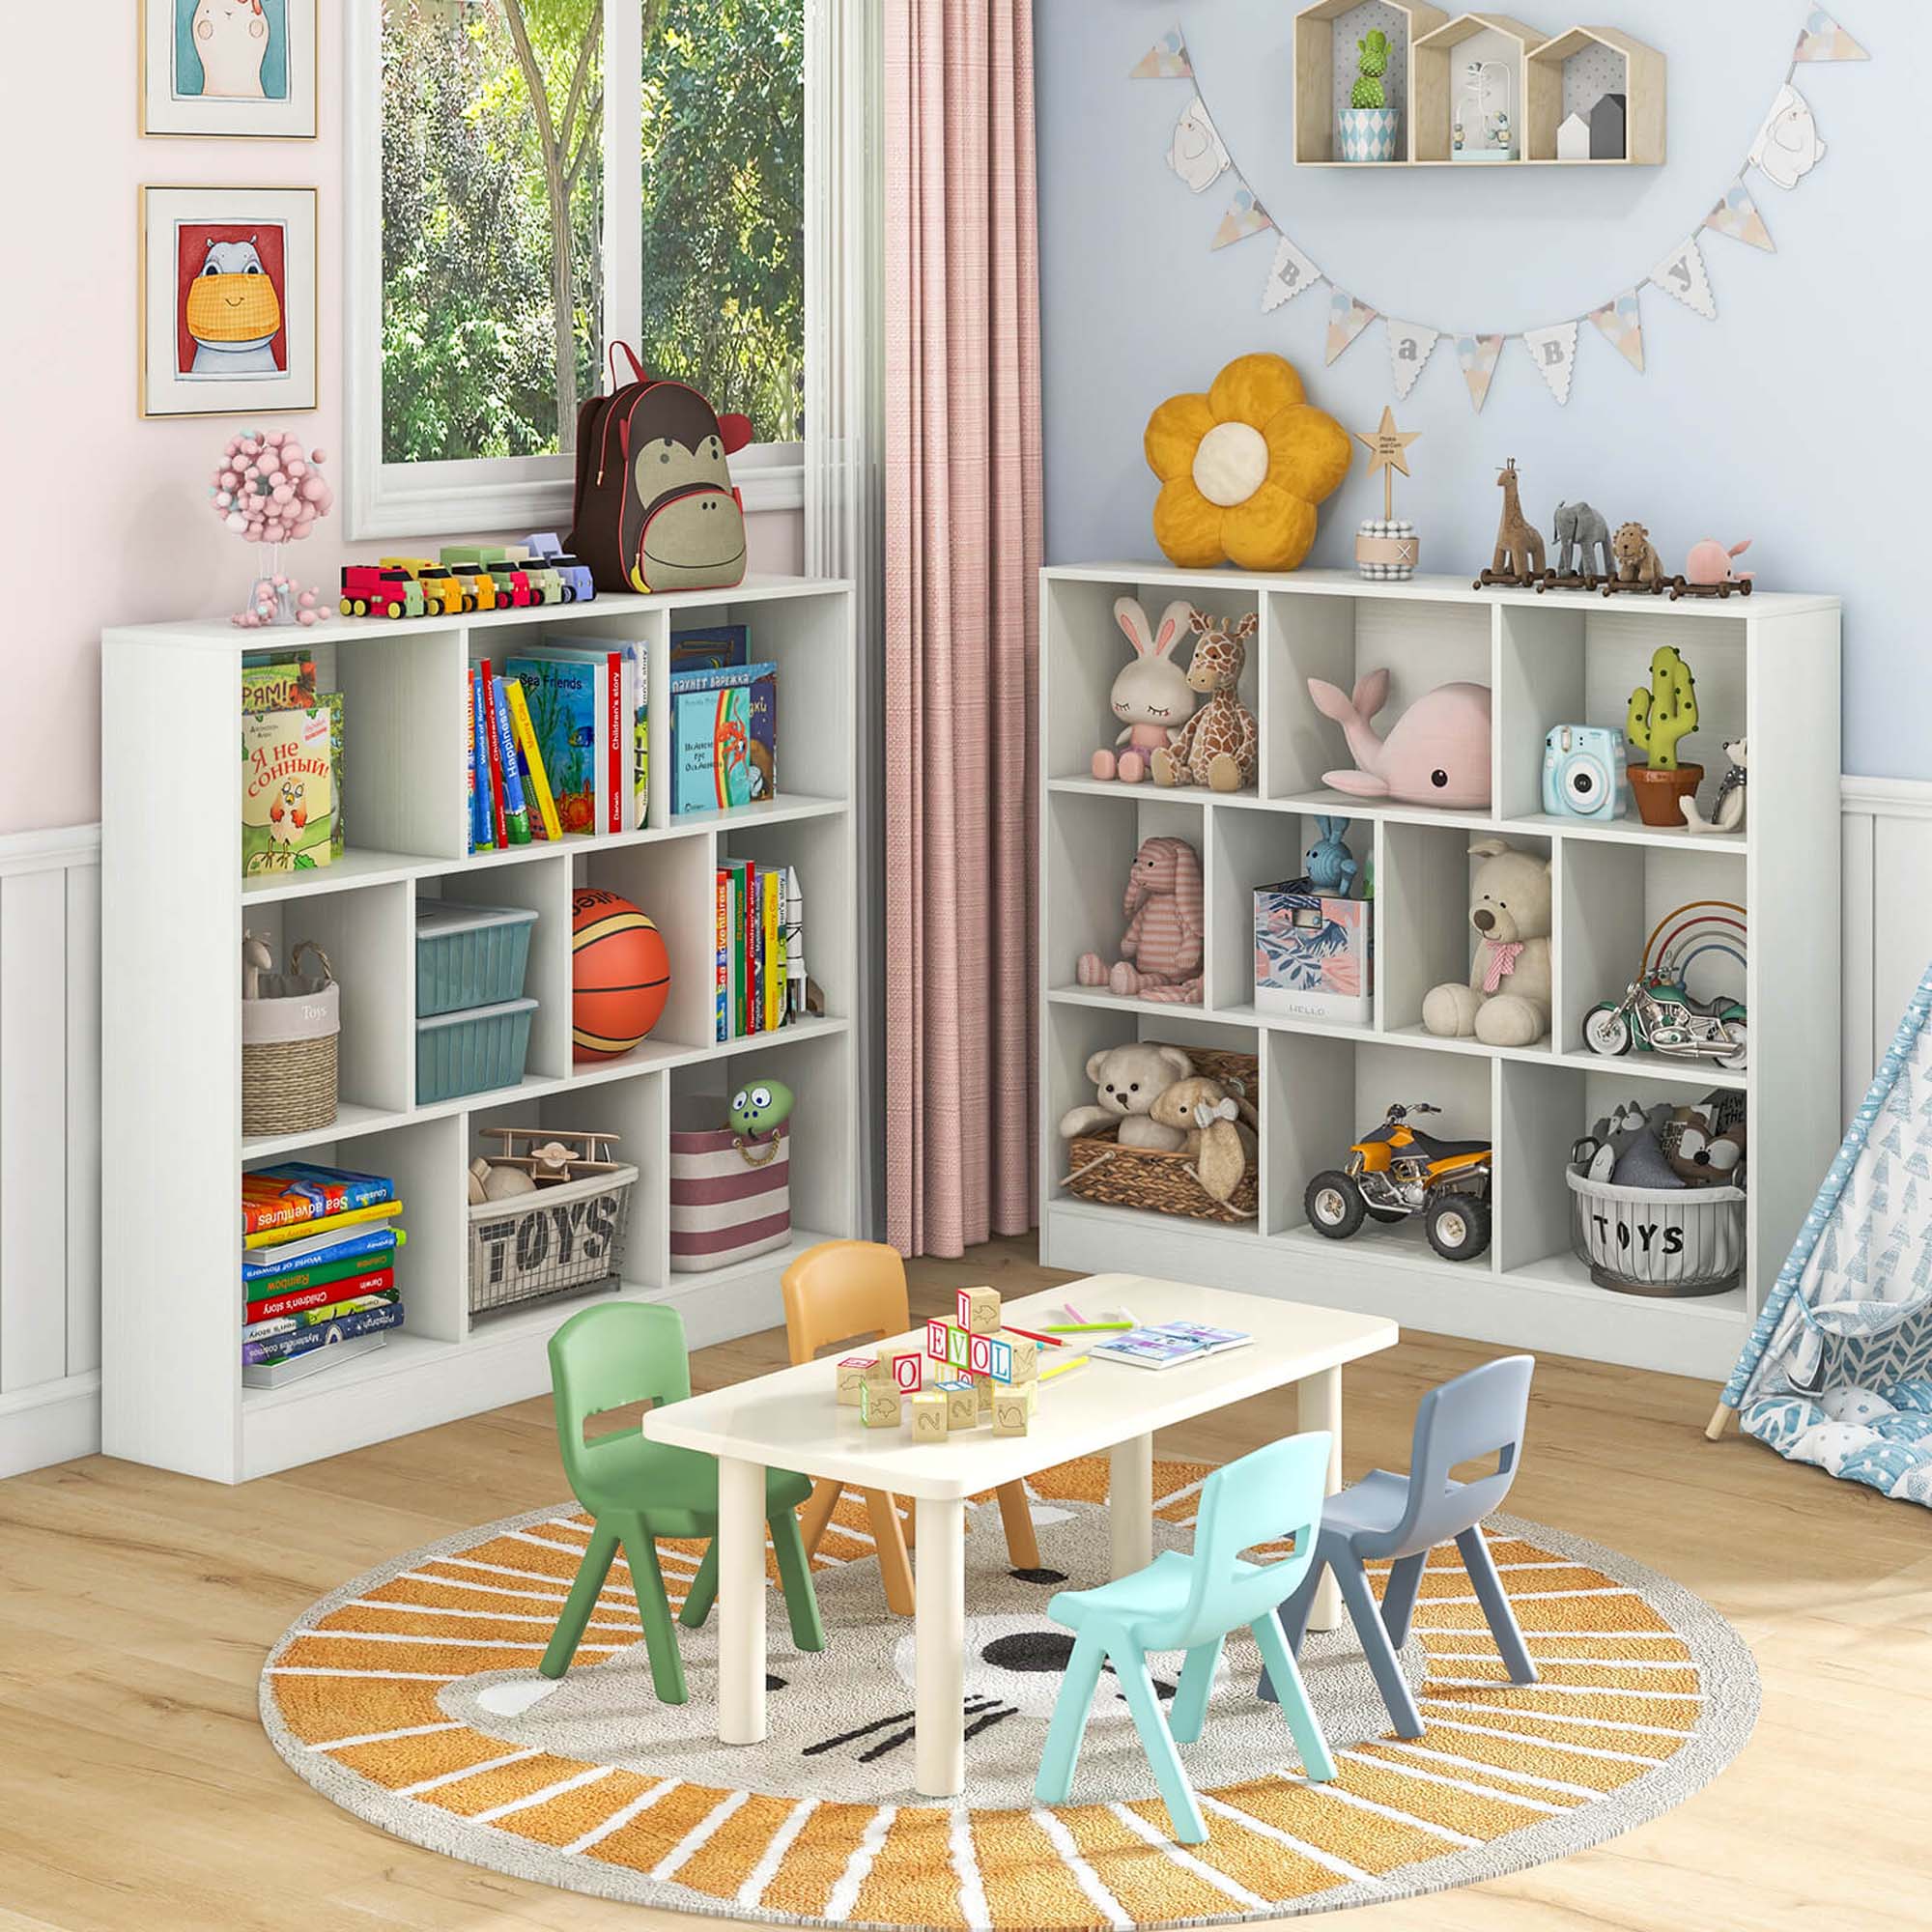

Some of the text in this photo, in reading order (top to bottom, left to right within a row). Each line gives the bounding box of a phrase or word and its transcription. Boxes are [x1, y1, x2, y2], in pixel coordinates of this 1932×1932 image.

[1278, 259, 1300, 287] B
[1399, 338, 1417, 361] a
[1542, 340, 1565, 366] B
[520, 672, 582, 690] Sea Friends
[611, 699, 620, 751] Children's
[251, 742, 298, 774] Я не
[248, 757, 329, 798] сонный!
[717, 886, 726, 994] Sea adventures
[301, 1005, 327, 1021] Toys
[258, 1196, 349, 1226] Sea adventures
[479, 1196, 618, 1284] TOYS
[1593, 1214, 1684, 1255] TOYS
[282, 1262, 292, 1271] of
[295, 1256, 323, 1268] World
[268, 1273, 310, 1292] Rainbow
[359, 1277, 383, 1290] Darwin
[263, 1292, 327, 1315] Children's story
[249, 1326, 270, 1339] story
